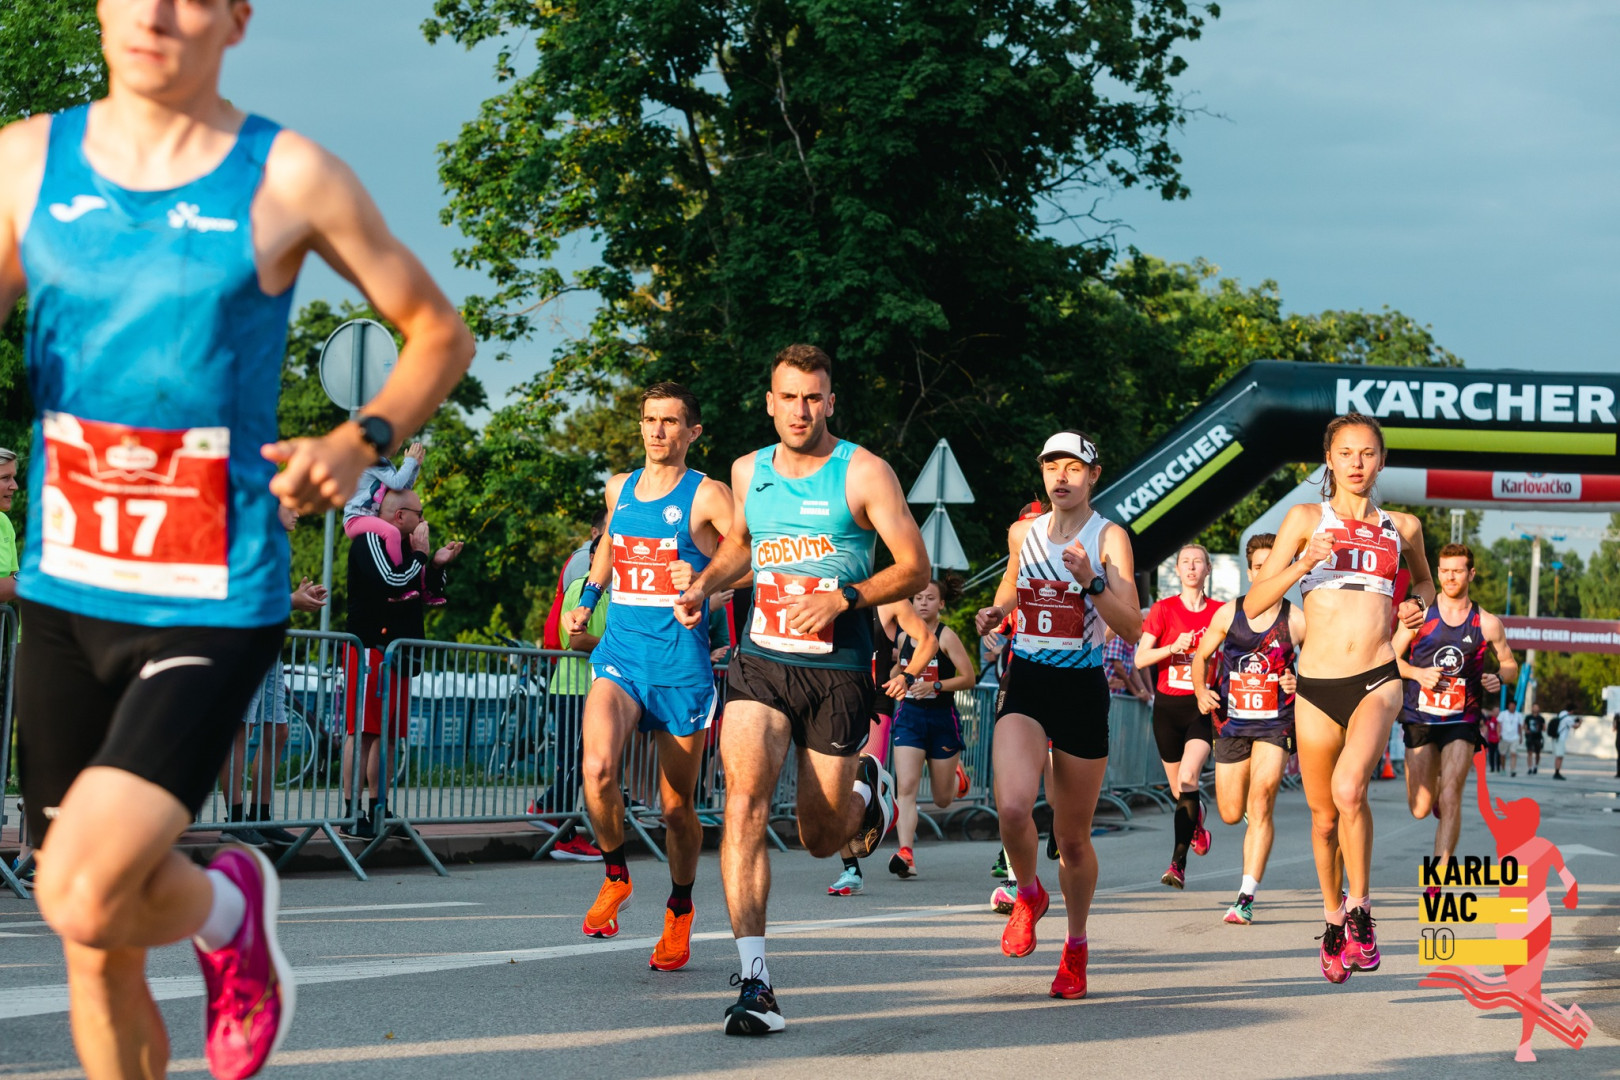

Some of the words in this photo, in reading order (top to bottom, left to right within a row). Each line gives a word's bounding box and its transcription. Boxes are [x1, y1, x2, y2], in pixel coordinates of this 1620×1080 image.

[1335, 378, 1617, 424] KÄRCHER
[1115, 424, 1234, 522] KÄRCHER
[1501, 478, 1572, 494] Karlovačko
[93, 496, 168, 557] 17
[757, 536, 834, 567] CEDEVITA
[1348, 548, 1377, 572] 10
[627, 567, 656, 591] 12
[1038, 610, 1052, 634] 6
[1570, 631, 1611, 644] powered
[1242, 692, 1263, 709] 16
[1433, 693, 1451, 708] 14
